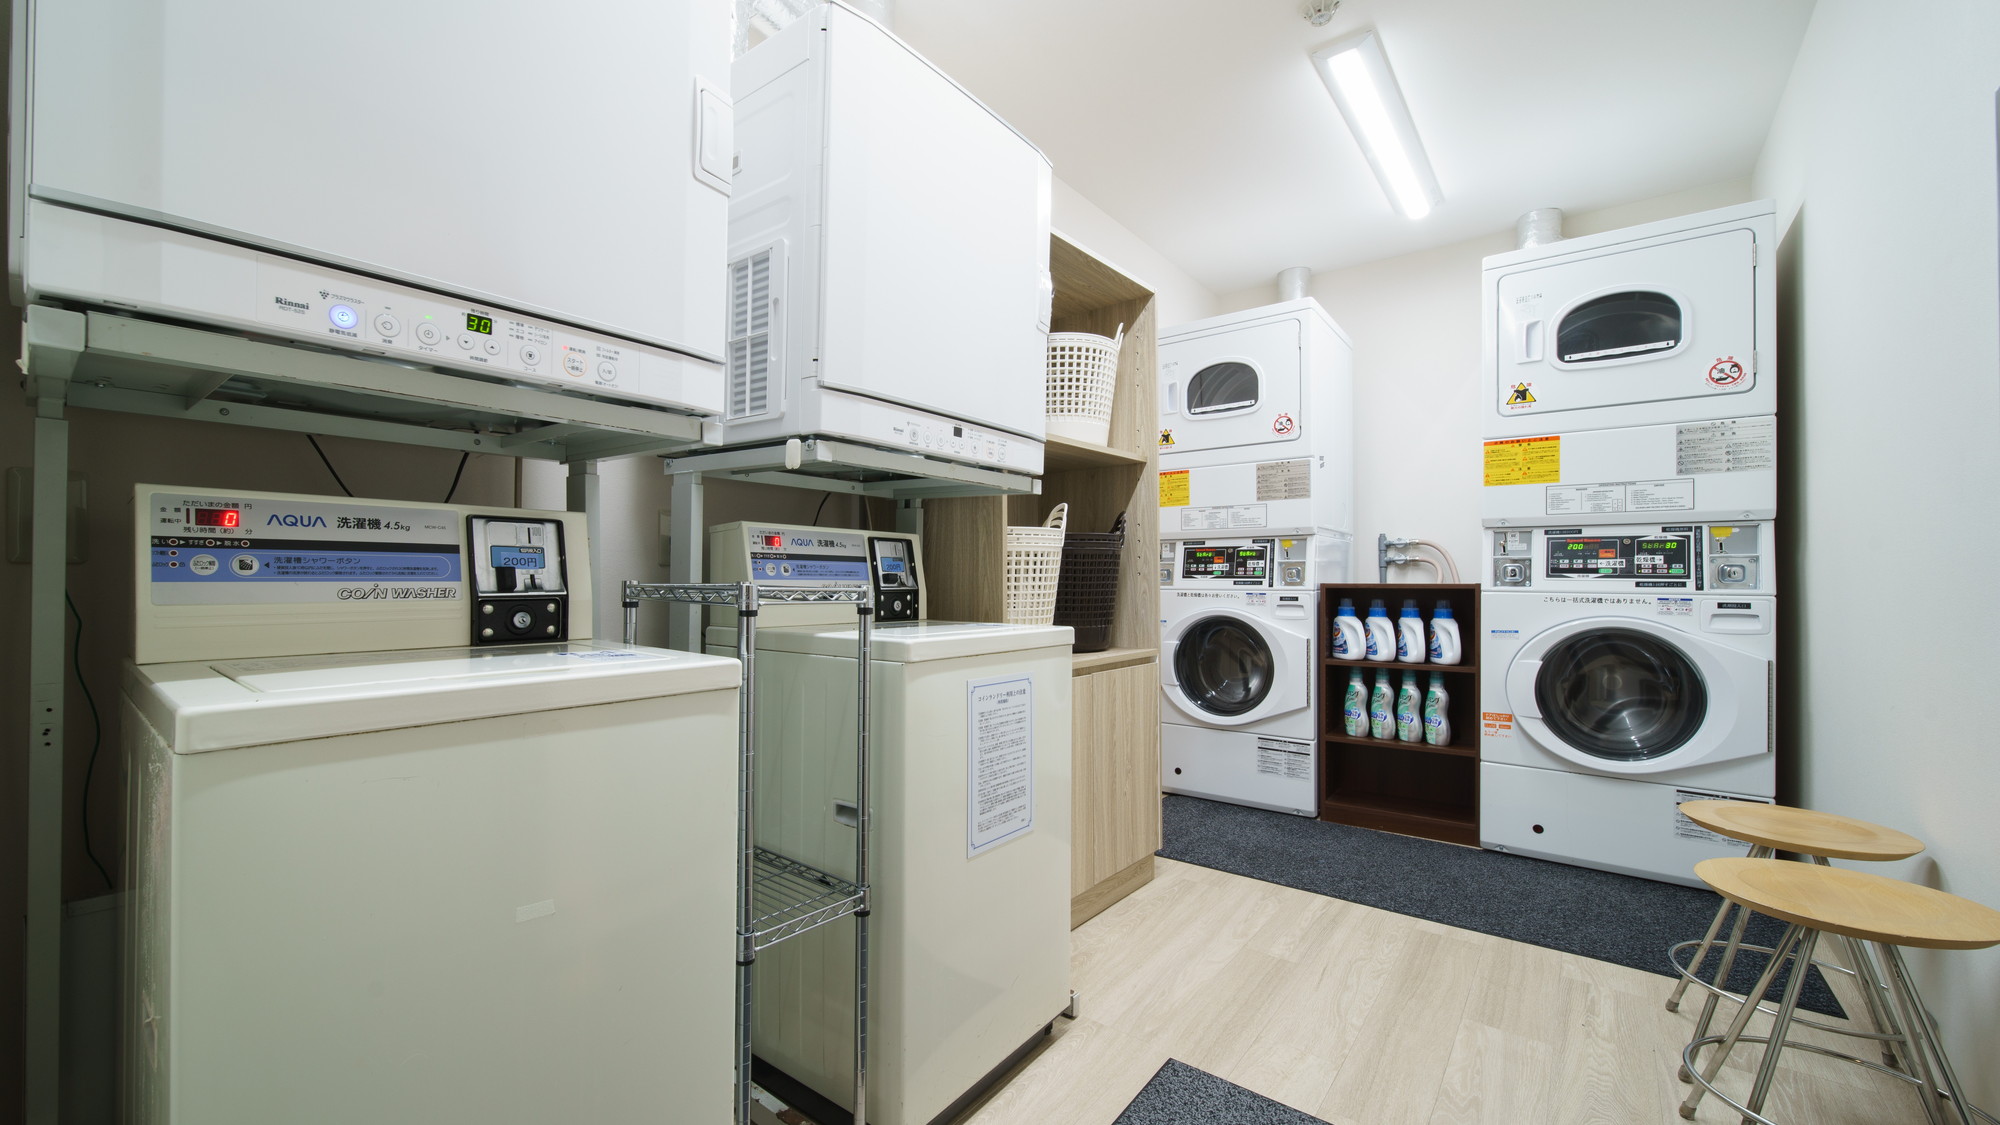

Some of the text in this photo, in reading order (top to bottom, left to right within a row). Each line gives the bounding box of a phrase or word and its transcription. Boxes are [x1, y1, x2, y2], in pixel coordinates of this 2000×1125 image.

[275, 296, 309, 310] Rinnai
[467, 316, 491, 333] 30
[182, 500, 240, 509] ただいまの金額
[224, 512, 237, 526] 0
[266, 514, 411, 532] AQUA 洗濯機 4.5kg
[183, 526, 216, 534] 残り時間
[791, 538, 814, 547] AQUA
[817, 539, 835, 548] 洗濯機
[273, 556, 361, 565] 洗濯槽シャワーボタン
[503, 557, 537, 568] 200円
[336, 583, 457, 600] COIN WASHER
